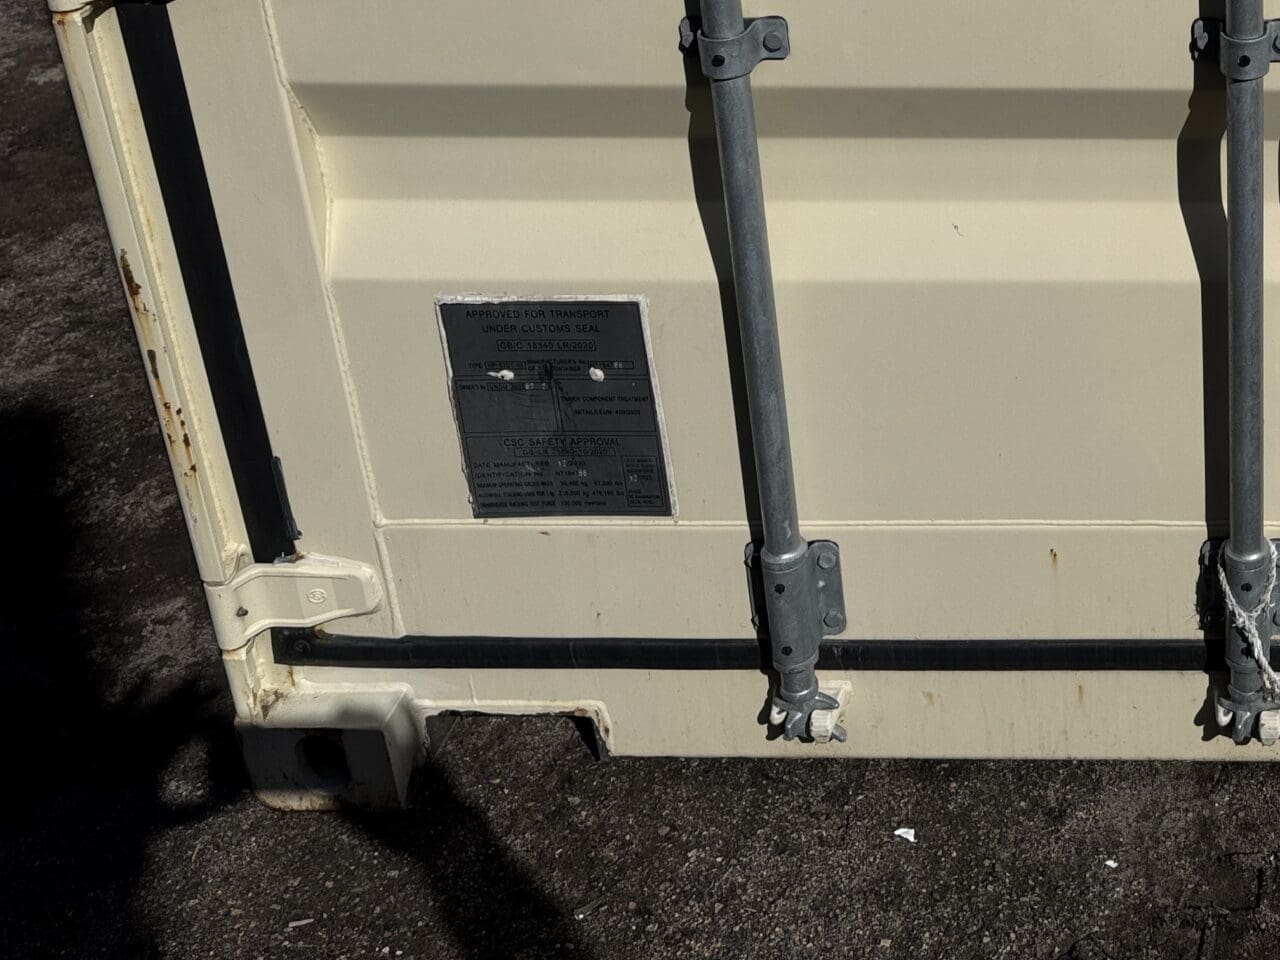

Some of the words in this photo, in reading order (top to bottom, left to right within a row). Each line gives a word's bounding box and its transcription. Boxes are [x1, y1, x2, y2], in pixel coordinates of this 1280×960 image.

[465, 309, 520, 319] APPROVED
[525, 309, 546, 319] FOR
[549, 309, 610, 319] TRANSPORT
[481, 324, 517, 333] UNDER
[521, 324, 571, 333] CUSTOMS
[575, 324, 600, 333] SEAL
[503, 438, 524, 447] CSC
[528, 437, 567, 447] SAFETY
[570, 437, 621, 446] APPROVAL
